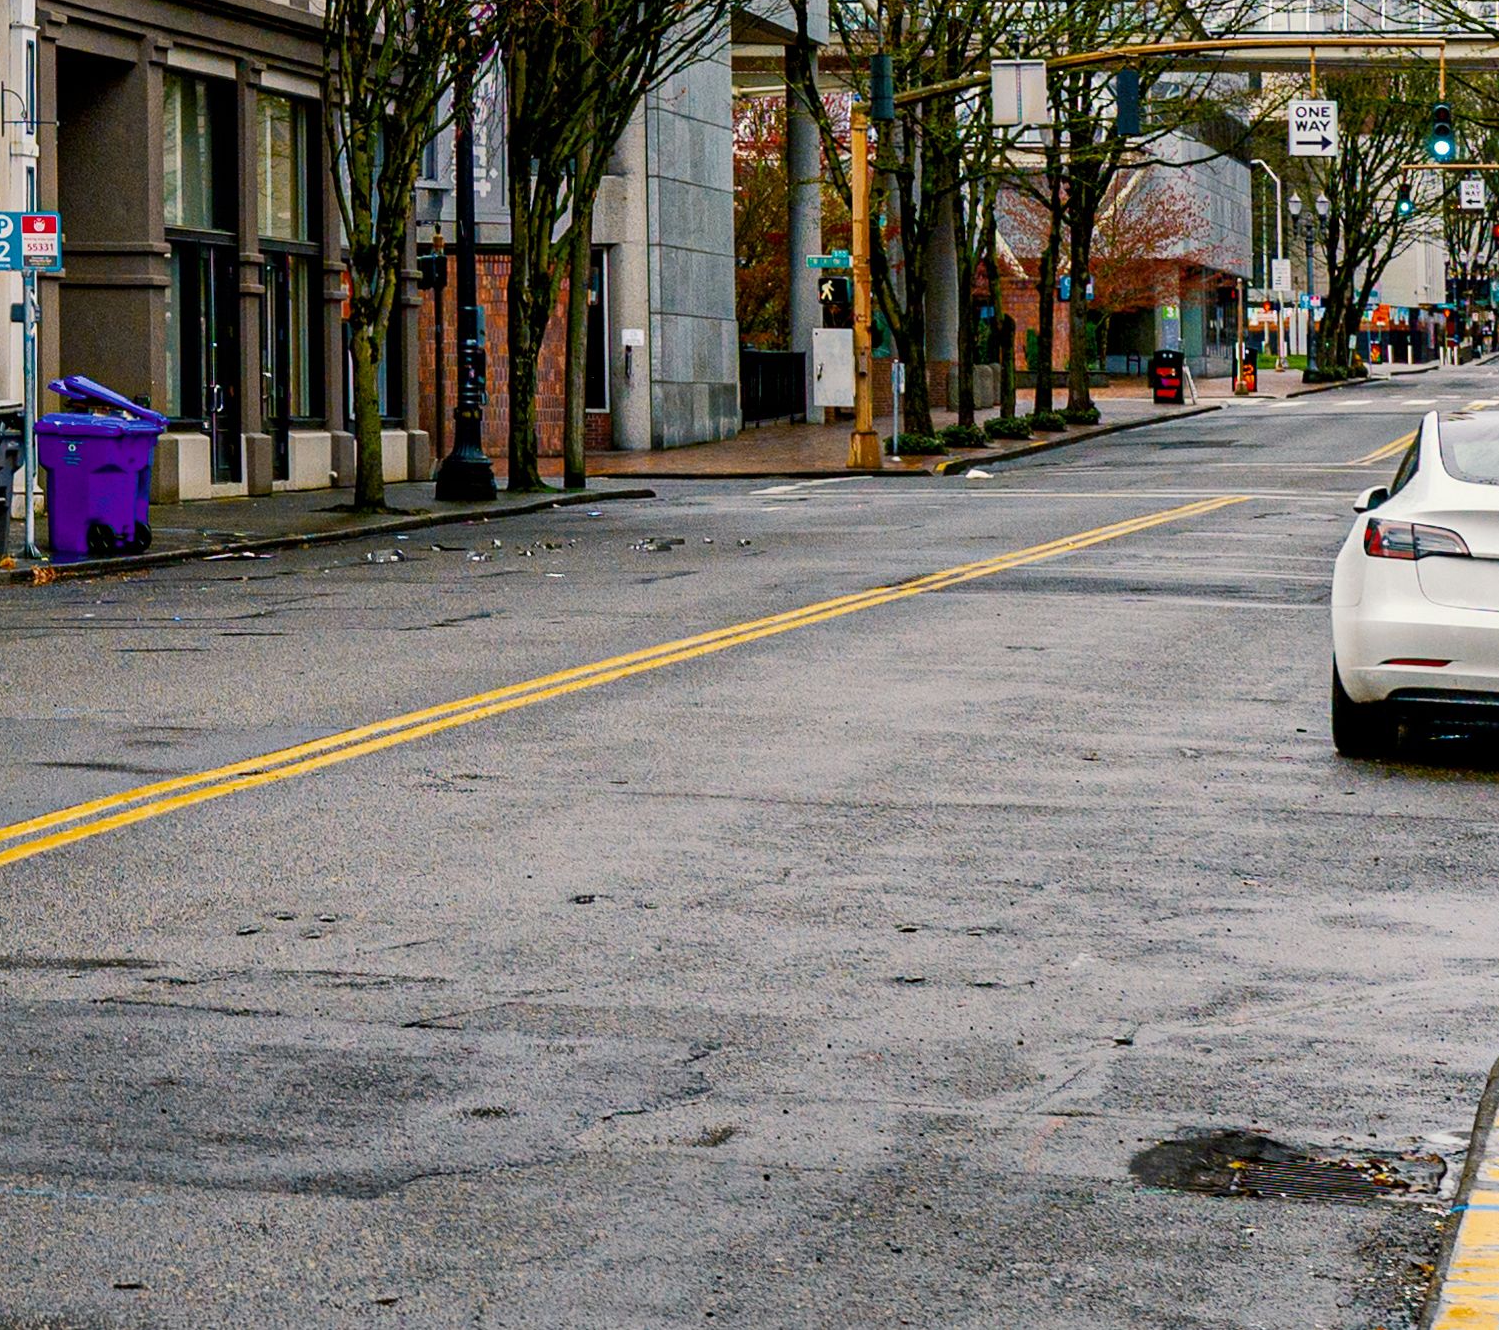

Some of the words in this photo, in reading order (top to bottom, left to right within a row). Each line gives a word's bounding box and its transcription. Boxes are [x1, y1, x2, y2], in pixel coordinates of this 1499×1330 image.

[1296, 106, 1331, 118] ONE
[1295, 120, 1331, 132] WAY
[1464, 182, 1480, 190] ONE
[27, 243, 54, 252] 55331
